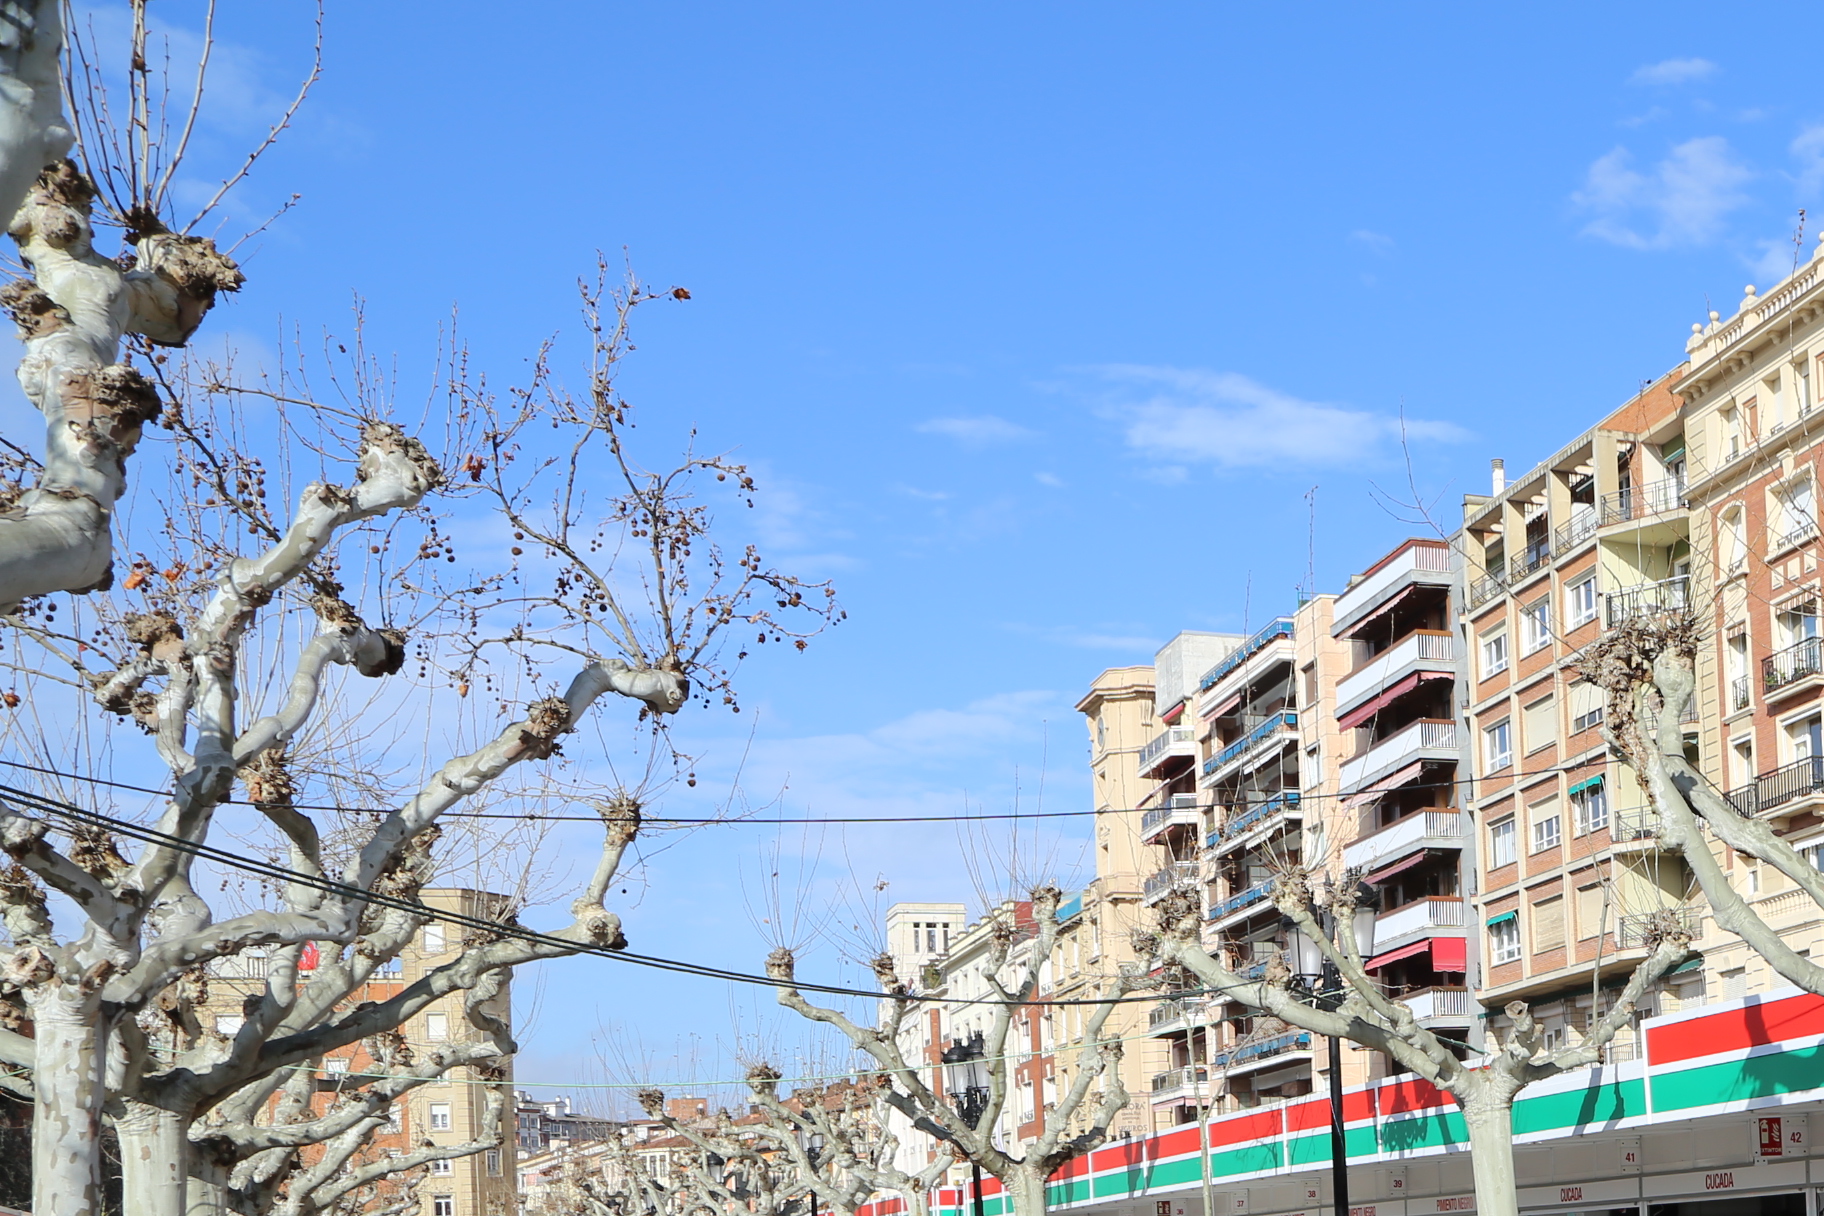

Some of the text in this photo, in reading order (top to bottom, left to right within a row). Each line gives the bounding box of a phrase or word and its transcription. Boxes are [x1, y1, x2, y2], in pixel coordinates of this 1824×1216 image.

[1790, 1132, 1802, 1143] 42
[1625, 1152, 1635, 1163] 41
[1393, 1180, 1403, 1188] 39
[1705, 1172, 1734, 1190] CUCADA
[1308, 1190, 1316, 1198] 38
[1560, 1186, 1583, 1202] CUCADA
